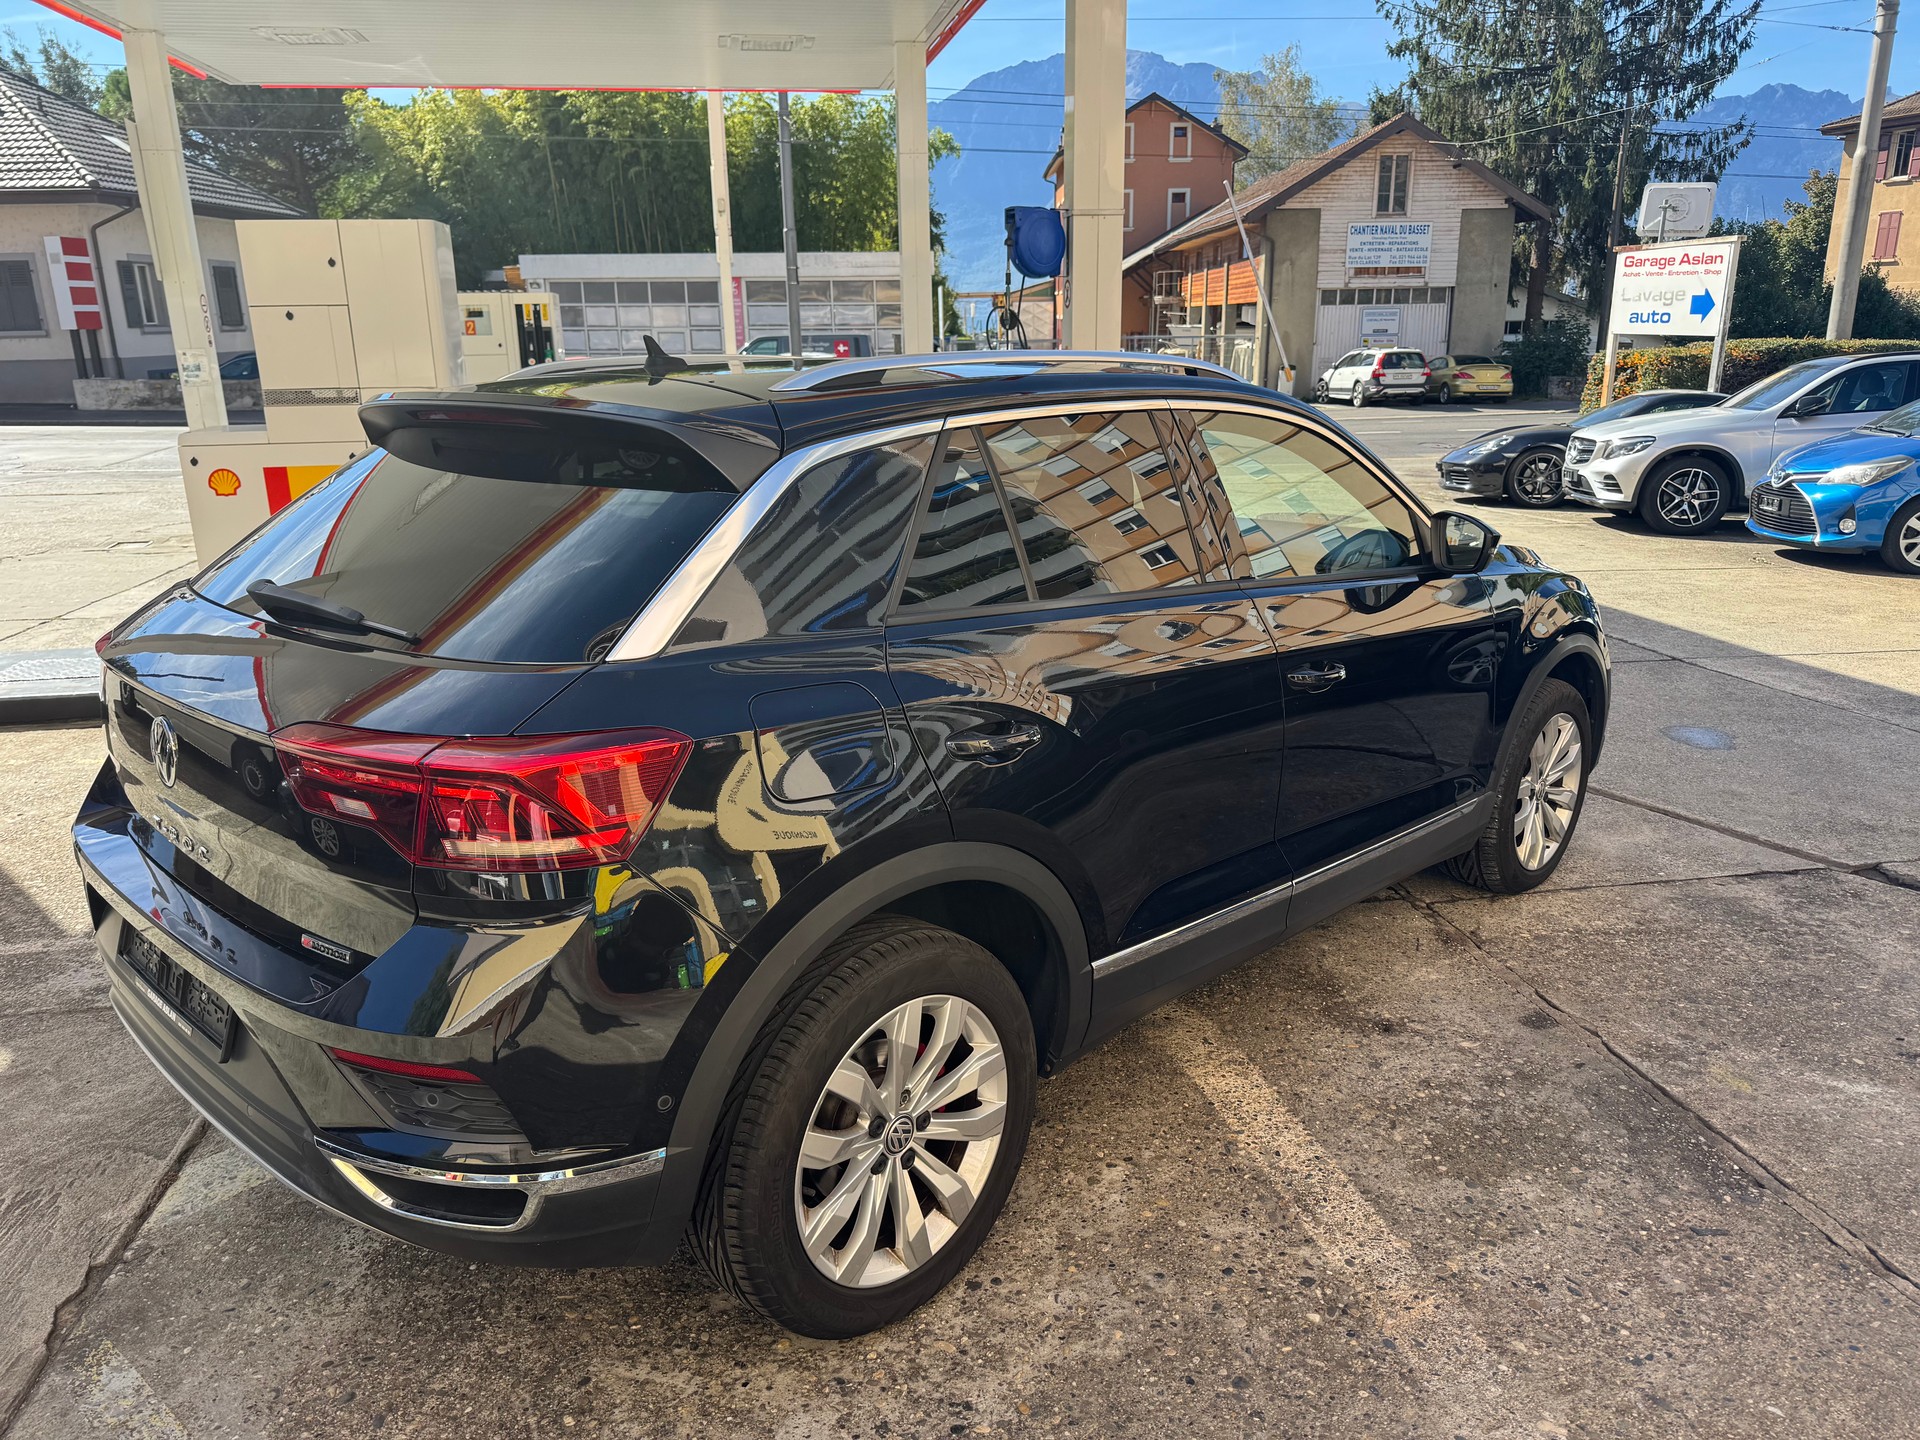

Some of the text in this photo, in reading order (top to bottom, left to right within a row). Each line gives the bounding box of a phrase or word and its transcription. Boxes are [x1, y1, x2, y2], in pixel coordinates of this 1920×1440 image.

[1350, 225, 1430, 235] CHANTIER NAVAL DU BASSET
[1623, 252, 1724, 270] Garage Aslan
[1621, 287, 1686, 306] Lavage
[1629, 310, 1671, 324] auto
[467, 322, 475, 334] 2
[147, 988, 177, 1022] GARAGE ASLAN
